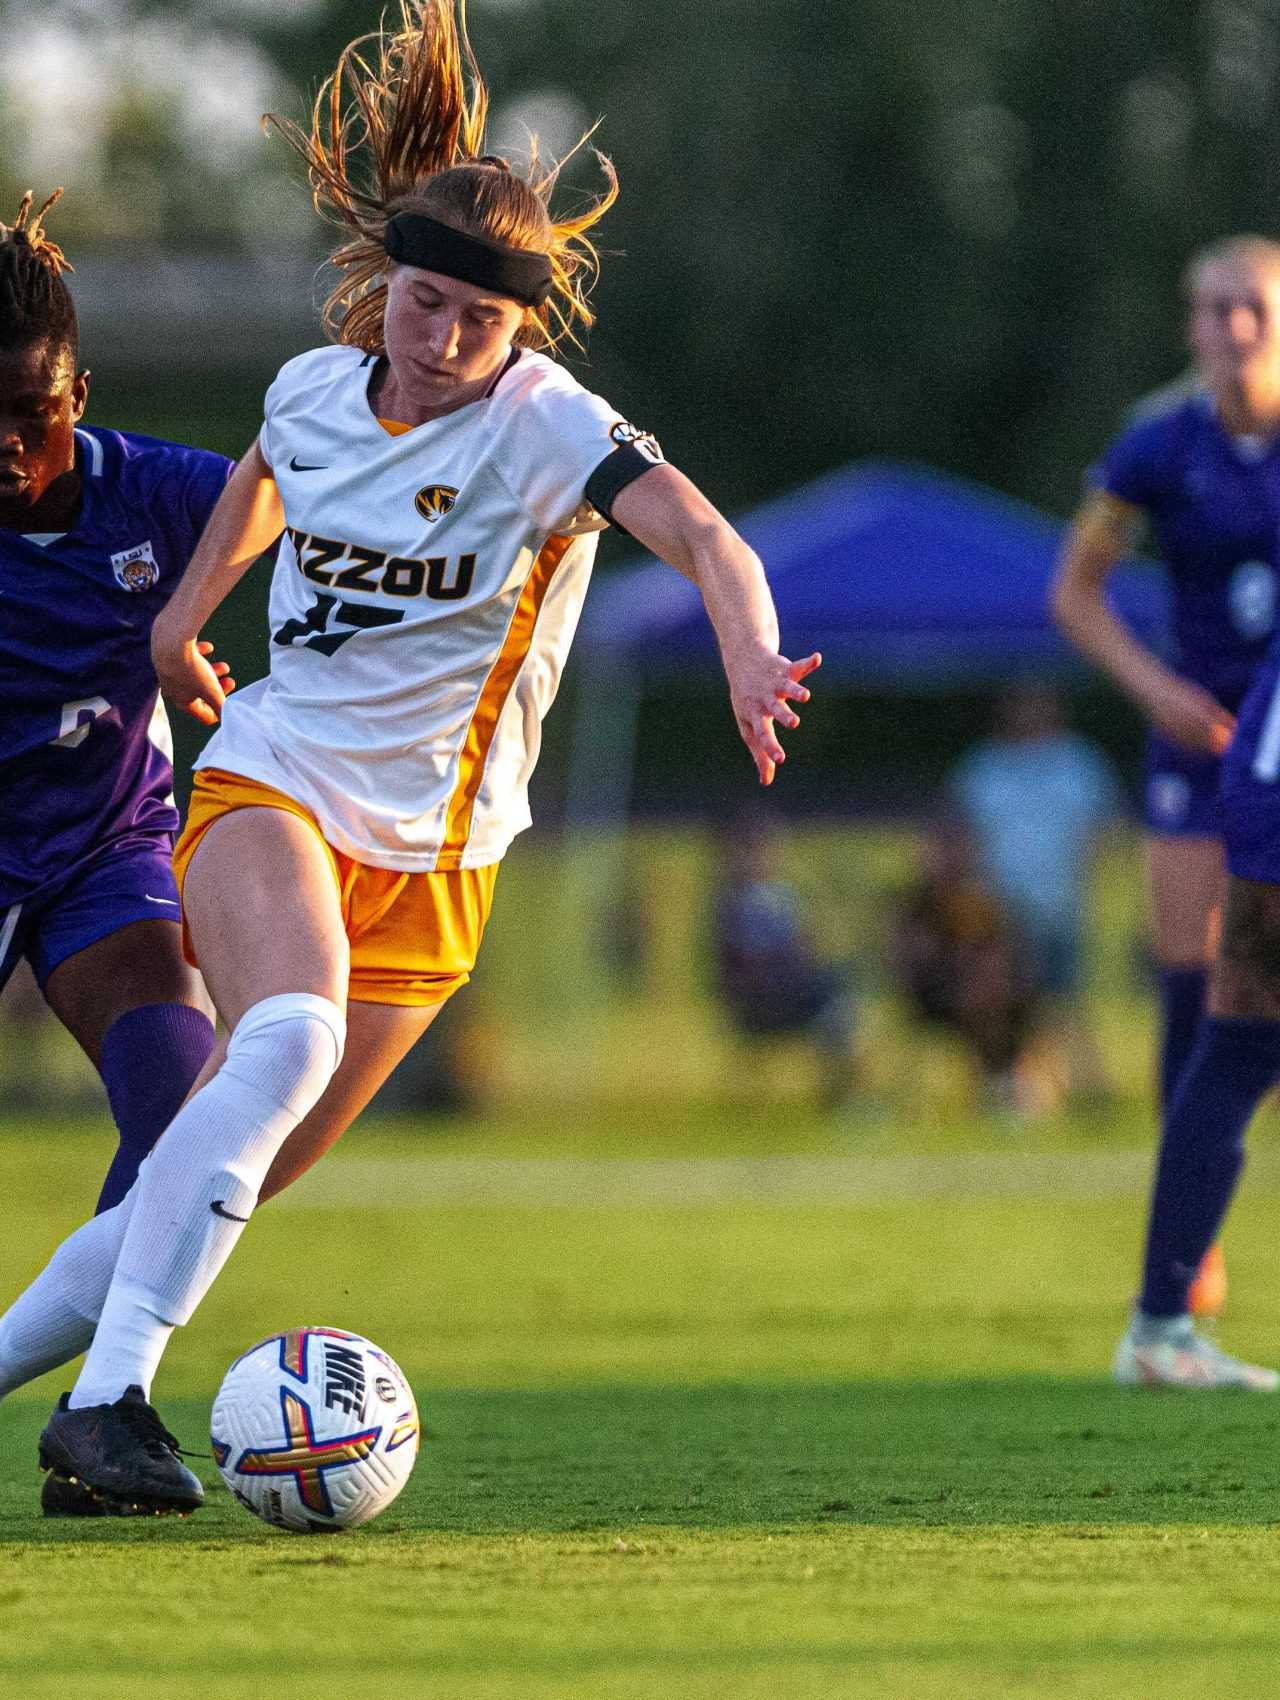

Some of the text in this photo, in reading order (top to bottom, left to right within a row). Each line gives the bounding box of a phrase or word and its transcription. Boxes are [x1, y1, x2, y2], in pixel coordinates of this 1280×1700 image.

[122, 549, 143, 562] LSU
[287, 526, 477, 600] IZZOU
[324, 1342, 365, 1424] NIKE
